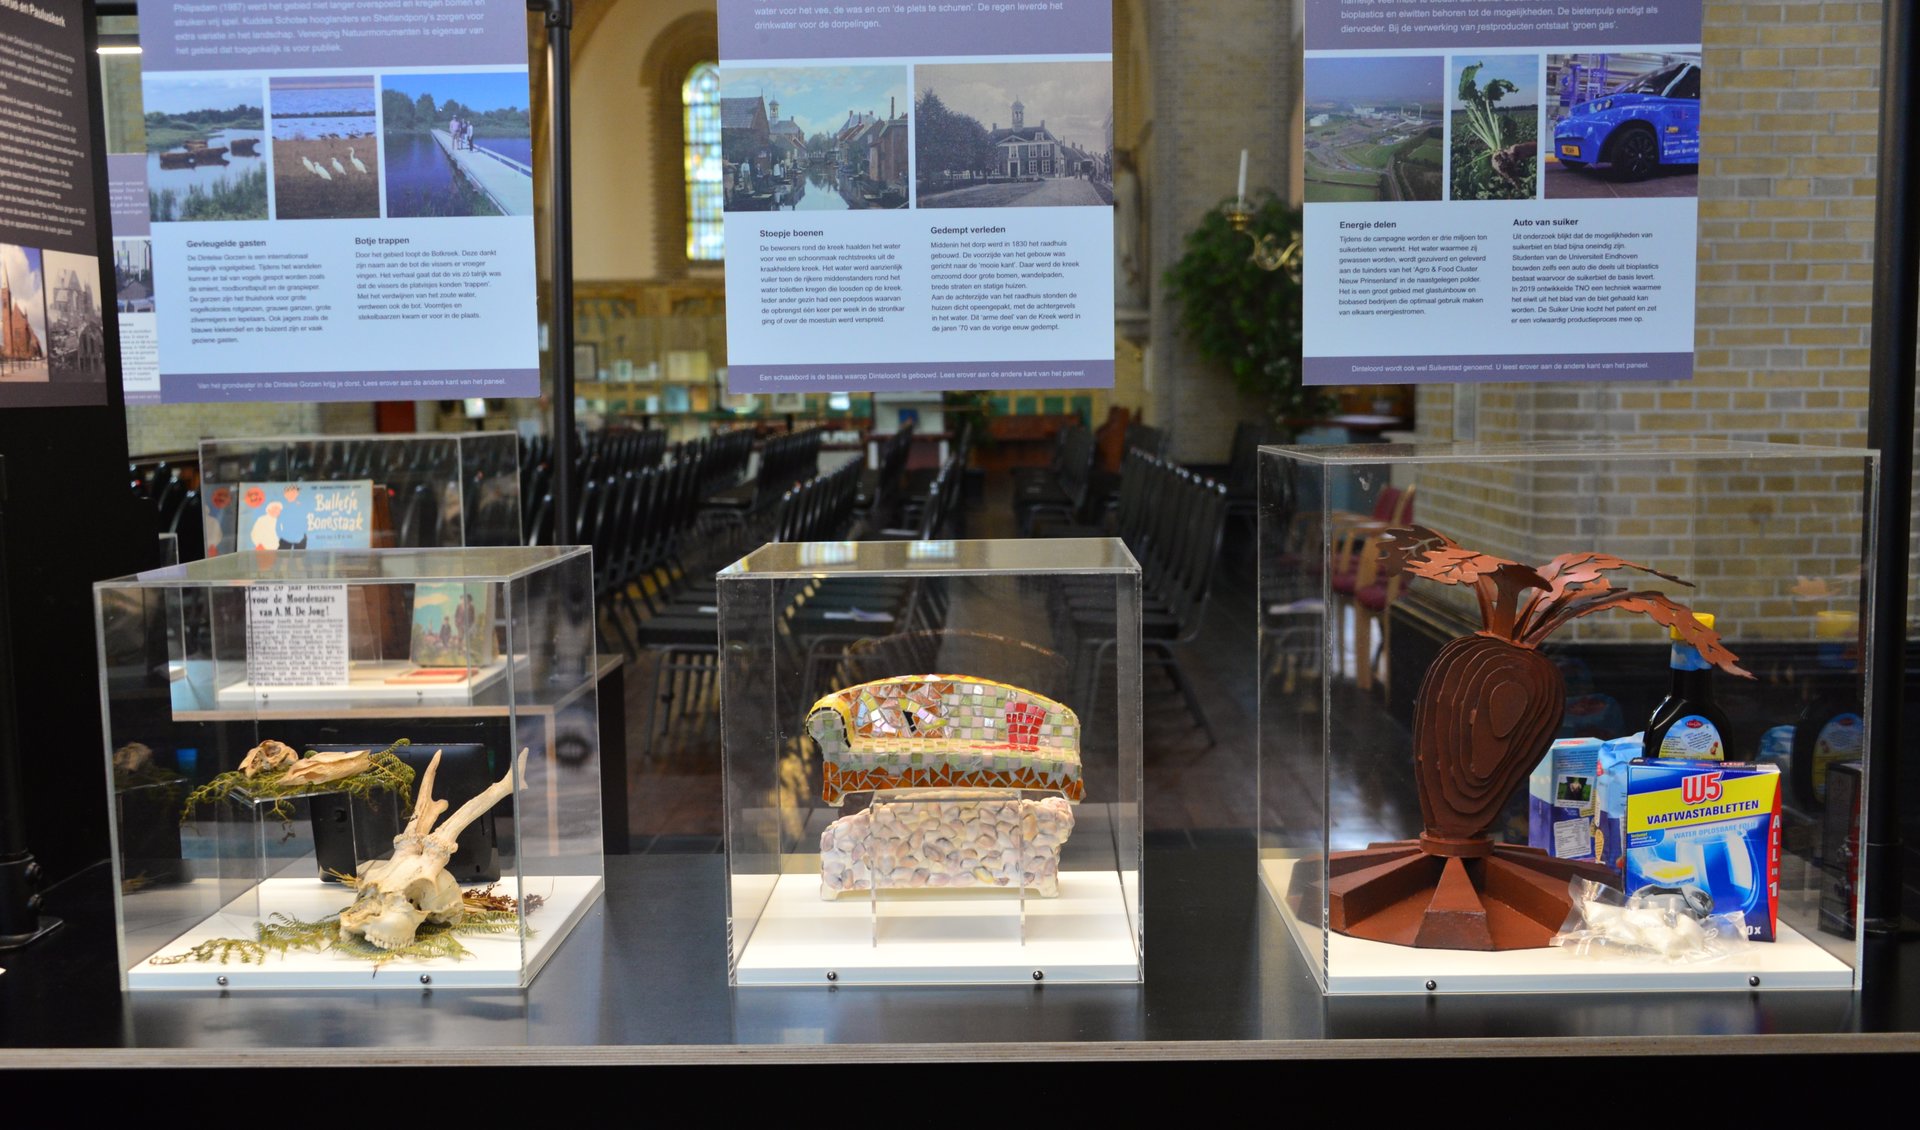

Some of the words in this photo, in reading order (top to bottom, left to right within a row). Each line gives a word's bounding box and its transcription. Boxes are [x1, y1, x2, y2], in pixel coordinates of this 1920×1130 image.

[992, 4, 1015, 12] regen
[1017, 2, 1048, 10] leverde
[1341, 10, 1384, 20] bioplastics
[1398, 9, 1430, 17] eiwitten
[1432, 9, 1466, 17] behoren
[1572, 6, 1614, 16] bietenpulp
[1616, 6, 1644, 16] eindigt
[754, 21, 797, 29] drinkwater
[1388, 24, 1399, 34] Bij
[1414, 23, 1458, 33] verwerking
[1478, 22, 1534, 32] restproducten
[1339, 221, 1372, 230] Energie
[759, 229, 791, 239] Stoepje
[930, 226, 968, 236] Gedempt
[186, 240, 237, 249] Gevleugelde
[239, 240, 266, 248] gasten
[354, 237, 376, 246] Botje
[378, 237, 410, 246] trappen
[1681, 771, 1724, 805] W5
[1647, 800, 1759, 825] VAATWASTABLETTEN
[1674, 830, 1697, 839] WATER
